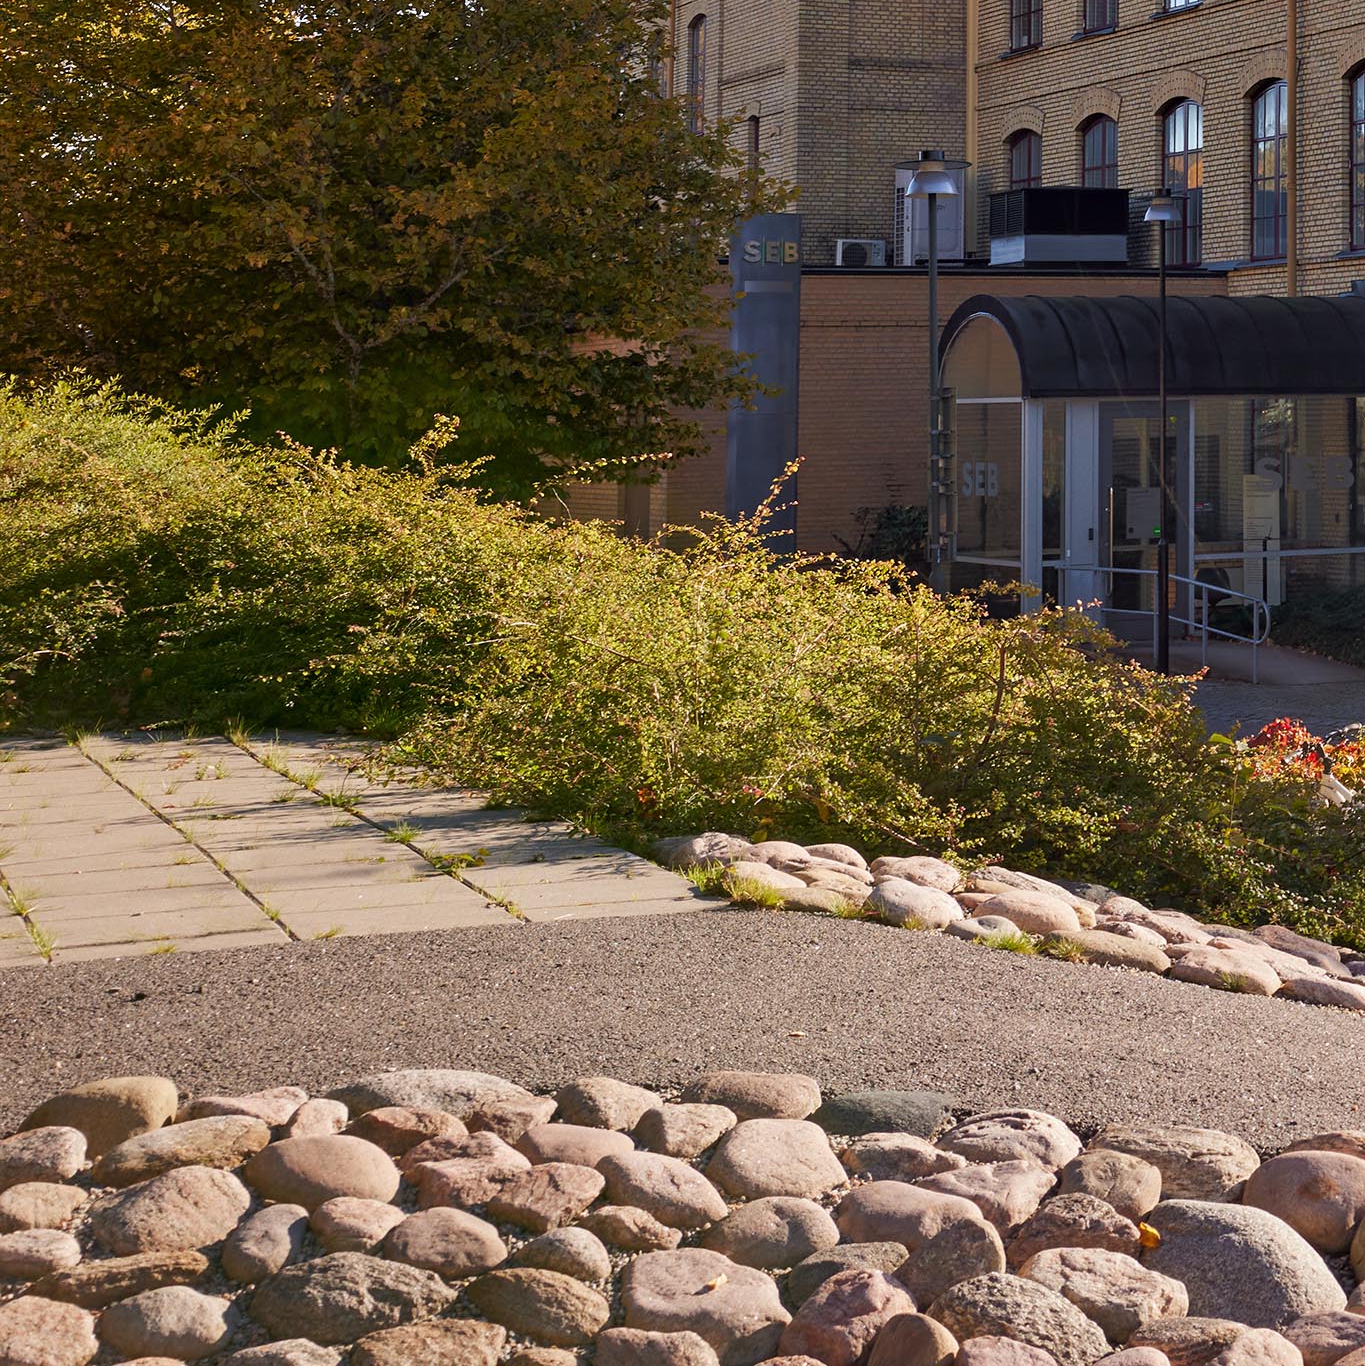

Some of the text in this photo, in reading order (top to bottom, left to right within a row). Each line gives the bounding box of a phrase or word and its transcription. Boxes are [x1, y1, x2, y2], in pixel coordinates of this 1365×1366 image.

[743, 239, 799, 264] SEB
[962, 461, 998, 497] SEB
[1254, 456, 1355, 491] SEB
